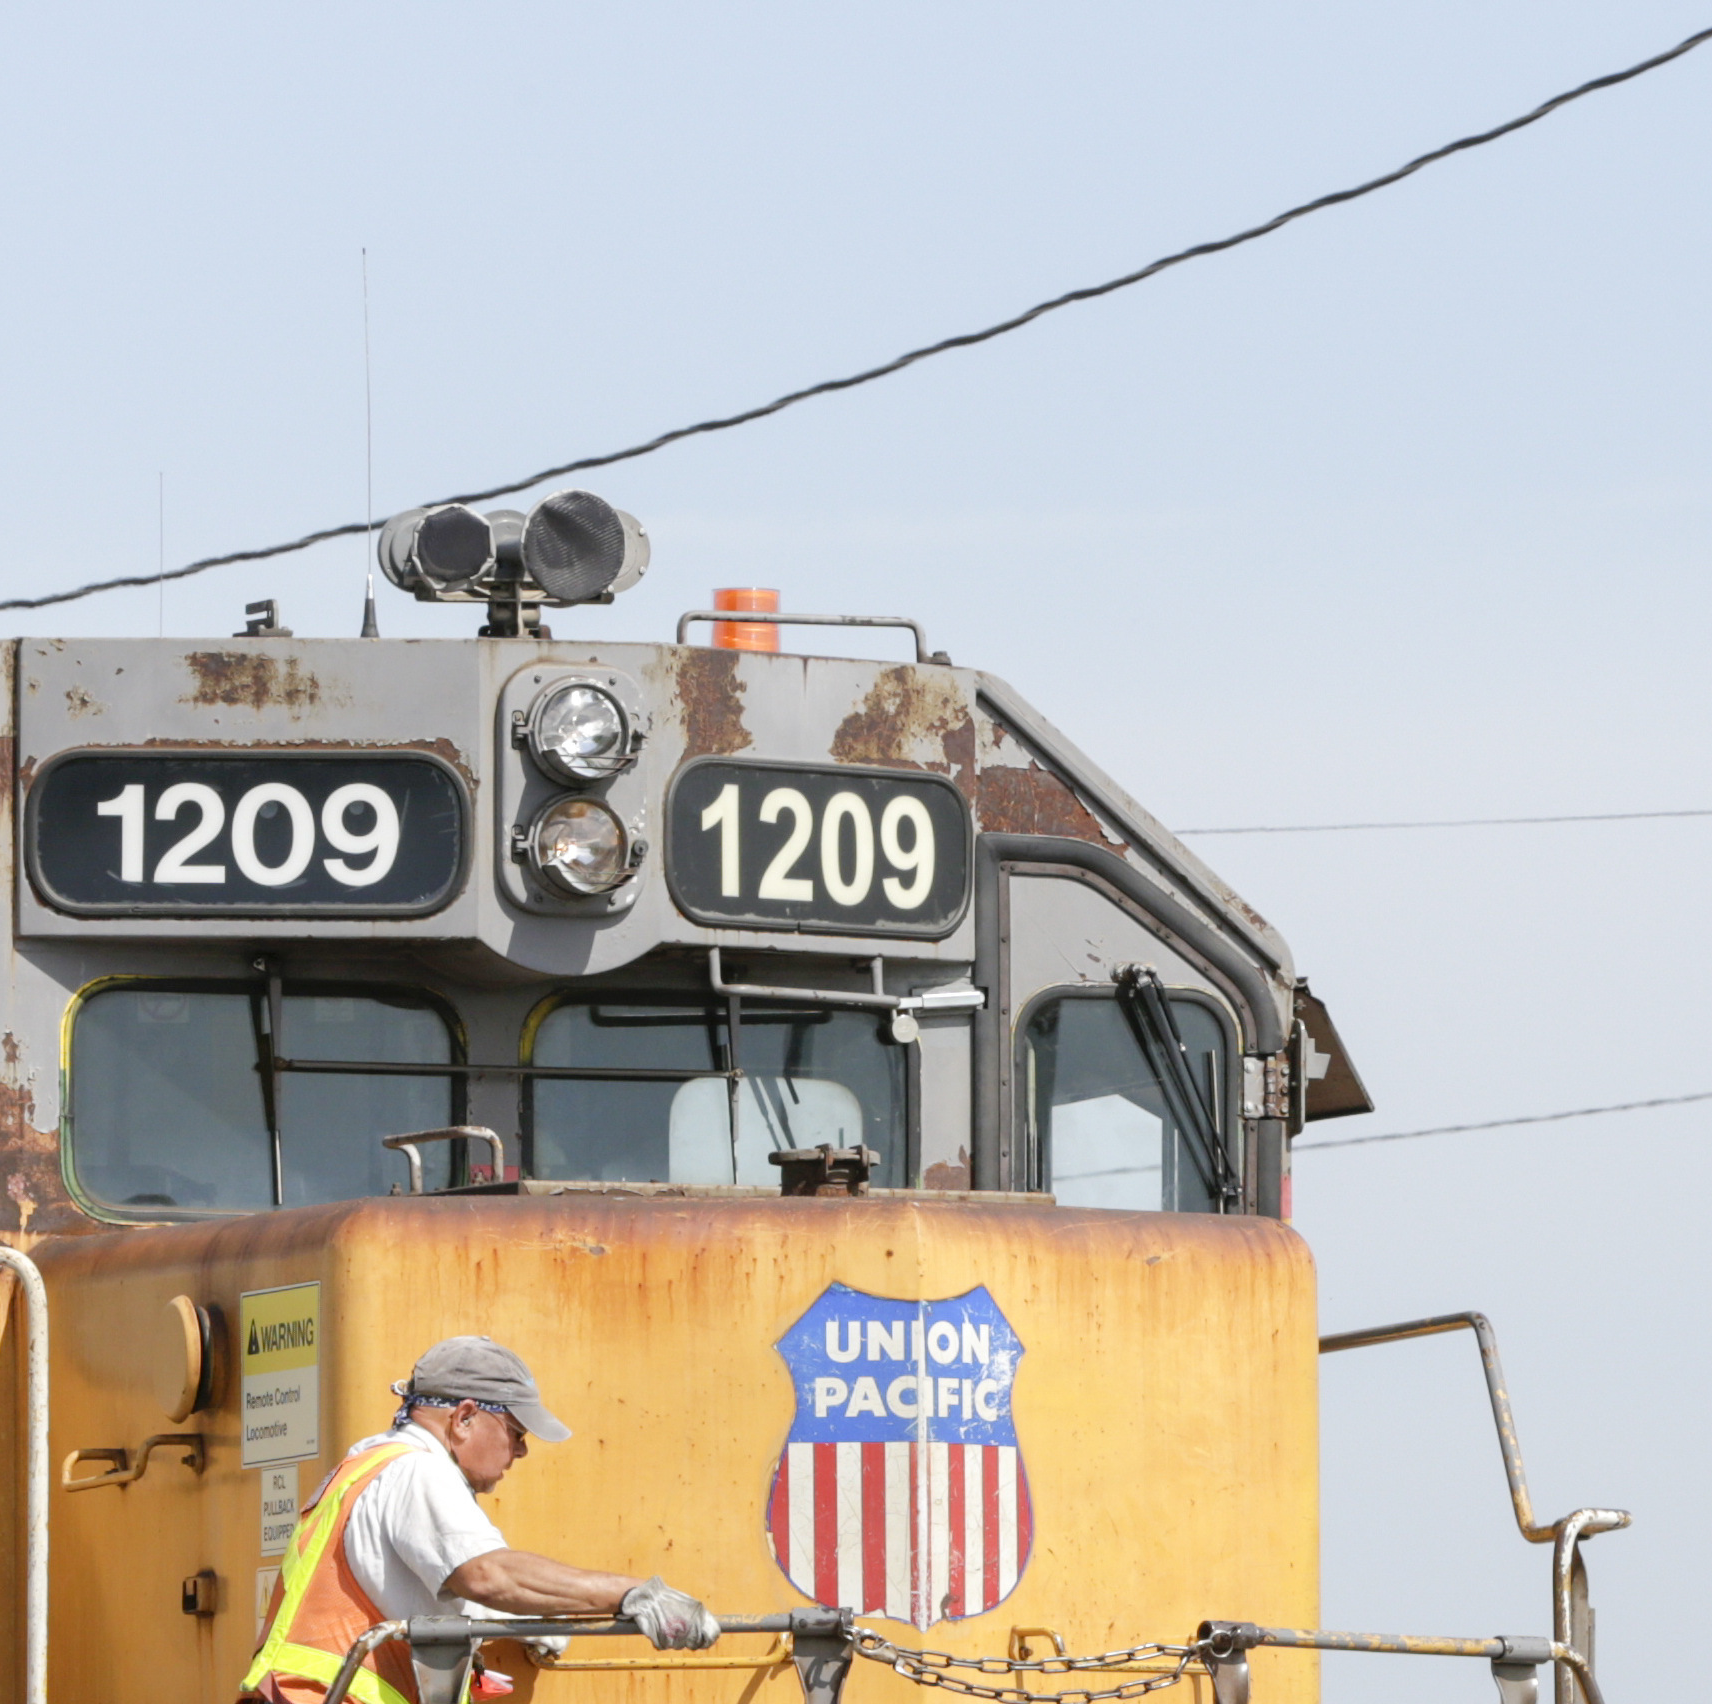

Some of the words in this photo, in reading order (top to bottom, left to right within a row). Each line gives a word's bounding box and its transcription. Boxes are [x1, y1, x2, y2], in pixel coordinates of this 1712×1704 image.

[95, 780, 400, 887] 1209
[700, 783, 936, 910] 1209
[261, 1317, 314, 1353] WARNING
[825, 1320, 990, 1365] UNION
[246, 1391, 274, 1410] Remote
[275, 1385, 301, 1407] Control
[815, 1375, 998, 1422] PACIFIC
[246, 1420, 288, 1442] Locomotive
[272, 1475, 287, 1490] RCL
[263, 1498, 295, 1516] PULLBACK
[263, 1523, 294, 1542] EQUIPPED
